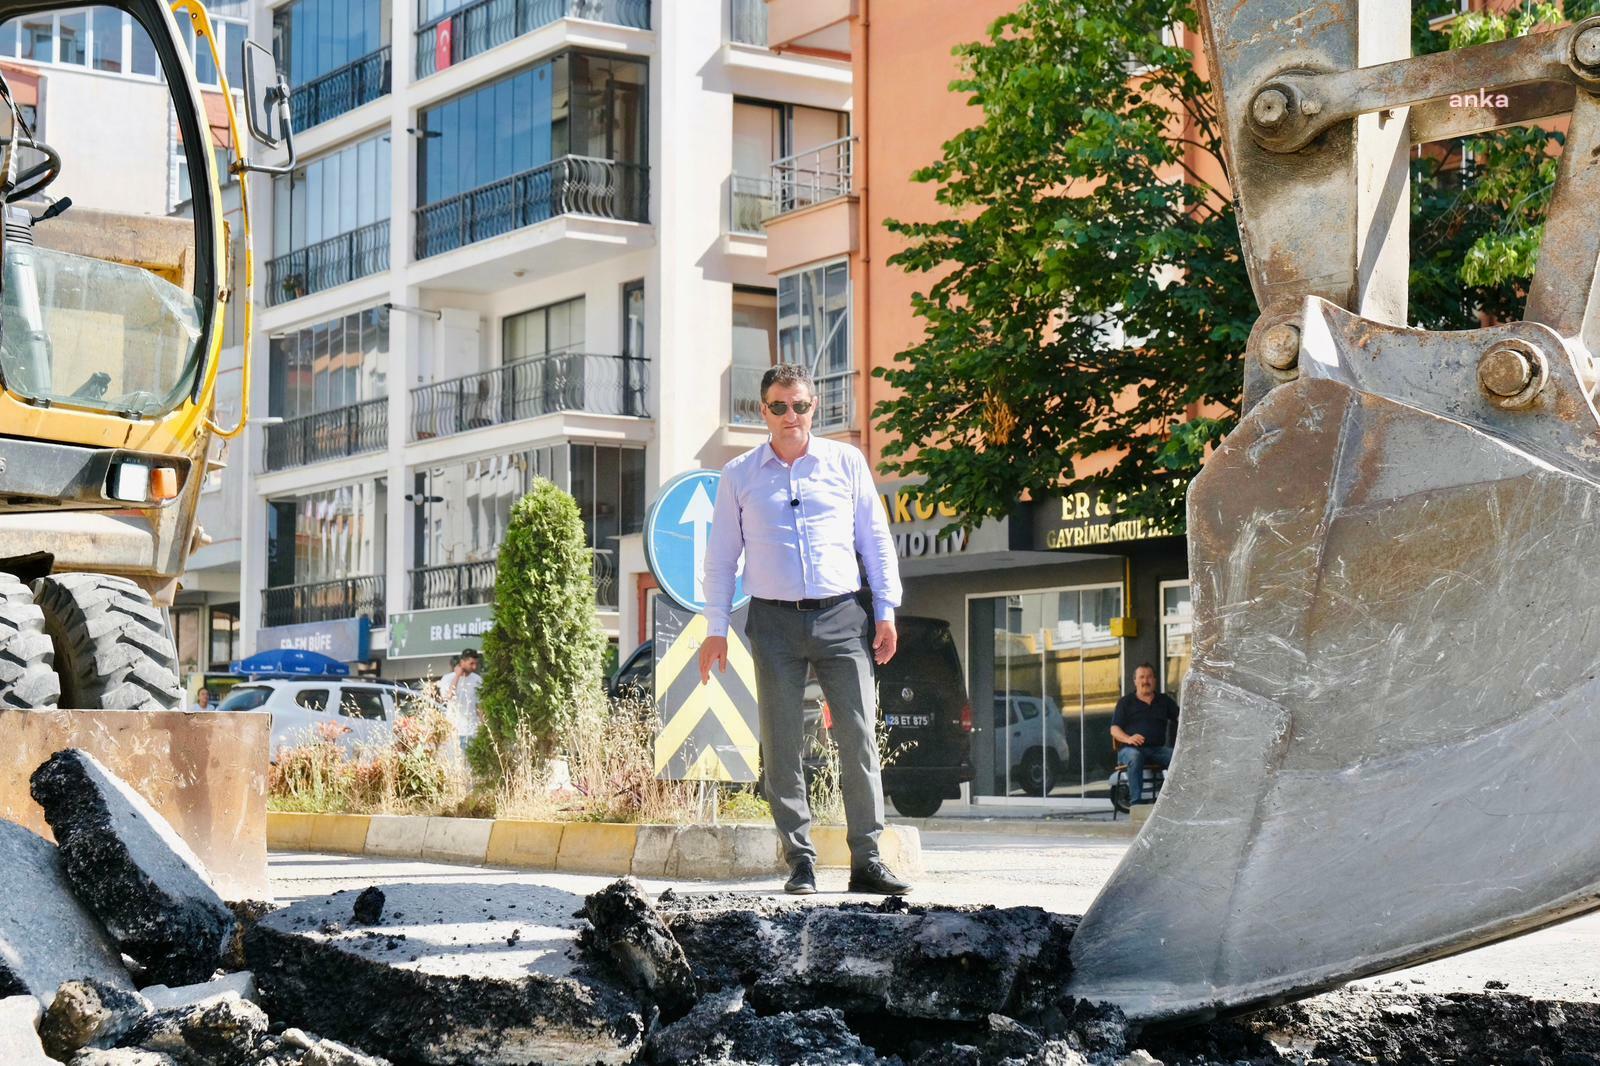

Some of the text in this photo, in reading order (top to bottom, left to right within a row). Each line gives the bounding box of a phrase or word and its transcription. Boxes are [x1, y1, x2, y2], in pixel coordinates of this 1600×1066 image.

[1061, 492, 1090, 520] ER
[1046, 520, 1145, 548] GAYRİMENKUL
[430, 625, 442, 641] ER
[443, 623, 451, 640] &
[452, 623, 467, 640] EM
[900, 715, 910, 725] ET
